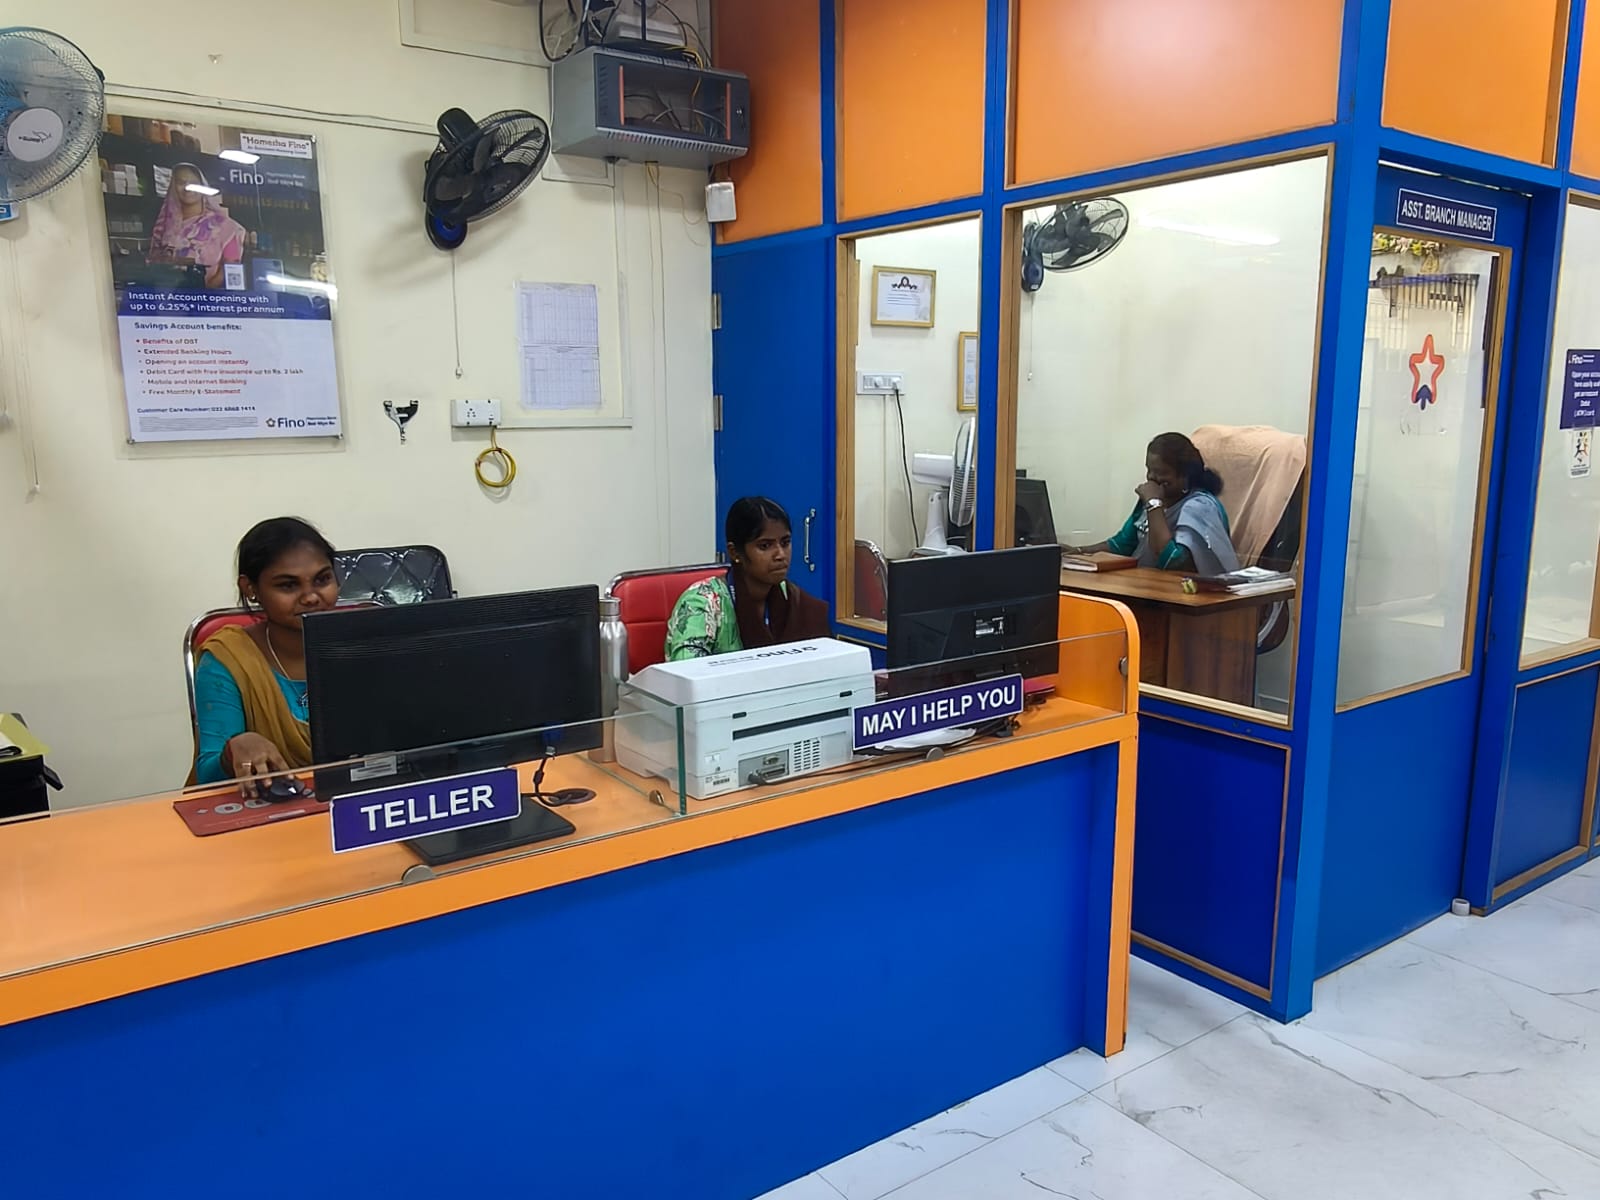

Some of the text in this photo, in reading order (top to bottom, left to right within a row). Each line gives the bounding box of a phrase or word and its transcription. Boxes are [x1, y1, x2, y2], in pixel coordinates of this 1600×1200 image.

[229, 168, 264, 185] Fino
[1401, 199, 1492, 232] ASST. BRANCH MANAGER
[128, 292, 269, 304] Instant Account opening with
[236, 305, 253, 314] per
[134, 322, 168, 330] Savings
[180, 348, 209, 356] Banking
[277, 417, 305, 428] Fino
[756, 648, 803, 658] Fino
[862, 684, 1016, 737] MAY I HELP YOU
[360, 784, 495, 832] TELLER
